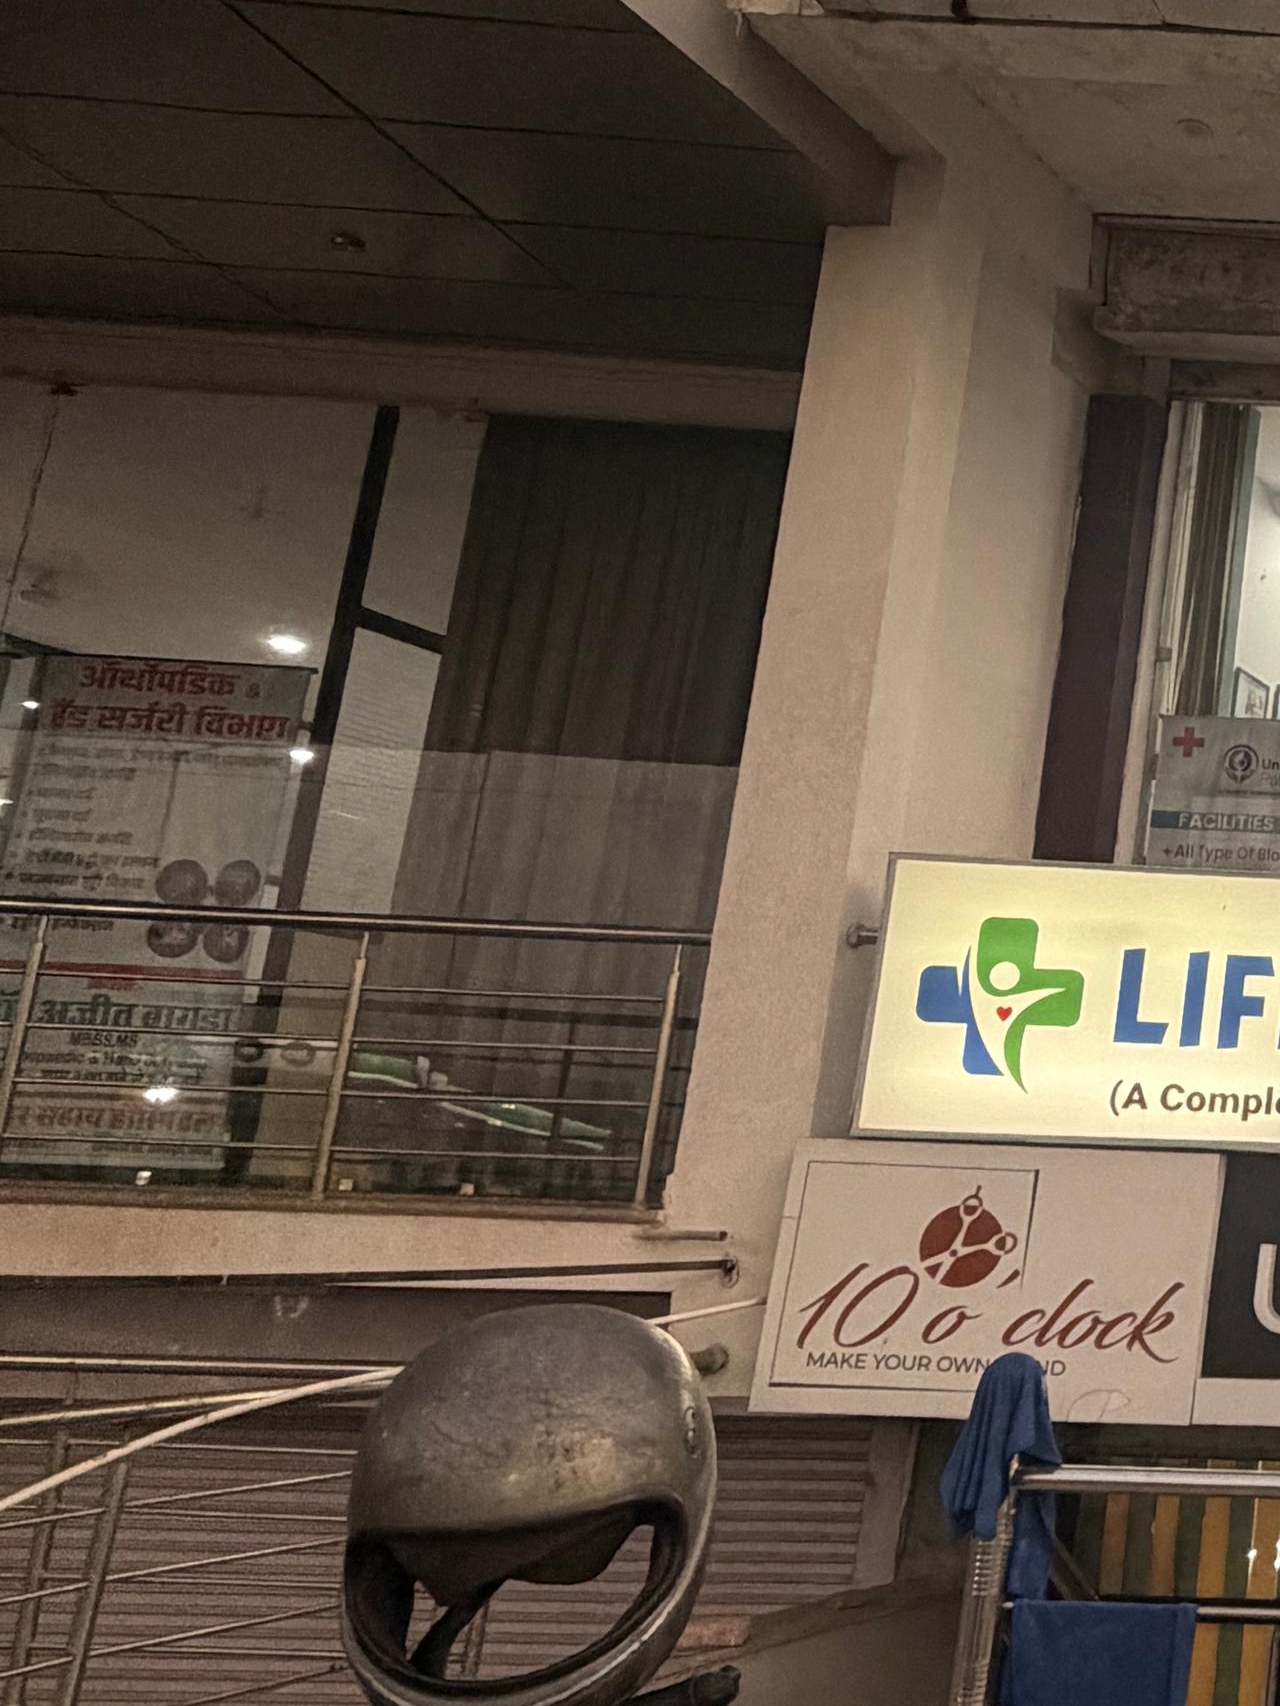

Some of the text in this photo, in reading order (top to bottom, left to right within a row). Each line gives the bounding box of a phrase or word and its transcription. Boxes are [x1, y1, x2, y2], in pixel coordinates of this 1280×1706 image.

[1178, 812, 1275, 831] FACILITIES
[1199, 845, 1233, 863] Type
[1109, 1079, 1147, 1121] (A
[797, 1263, 919, 1349] 10
[805, 1352, 990, 1374] MAKE YOUR OWN
